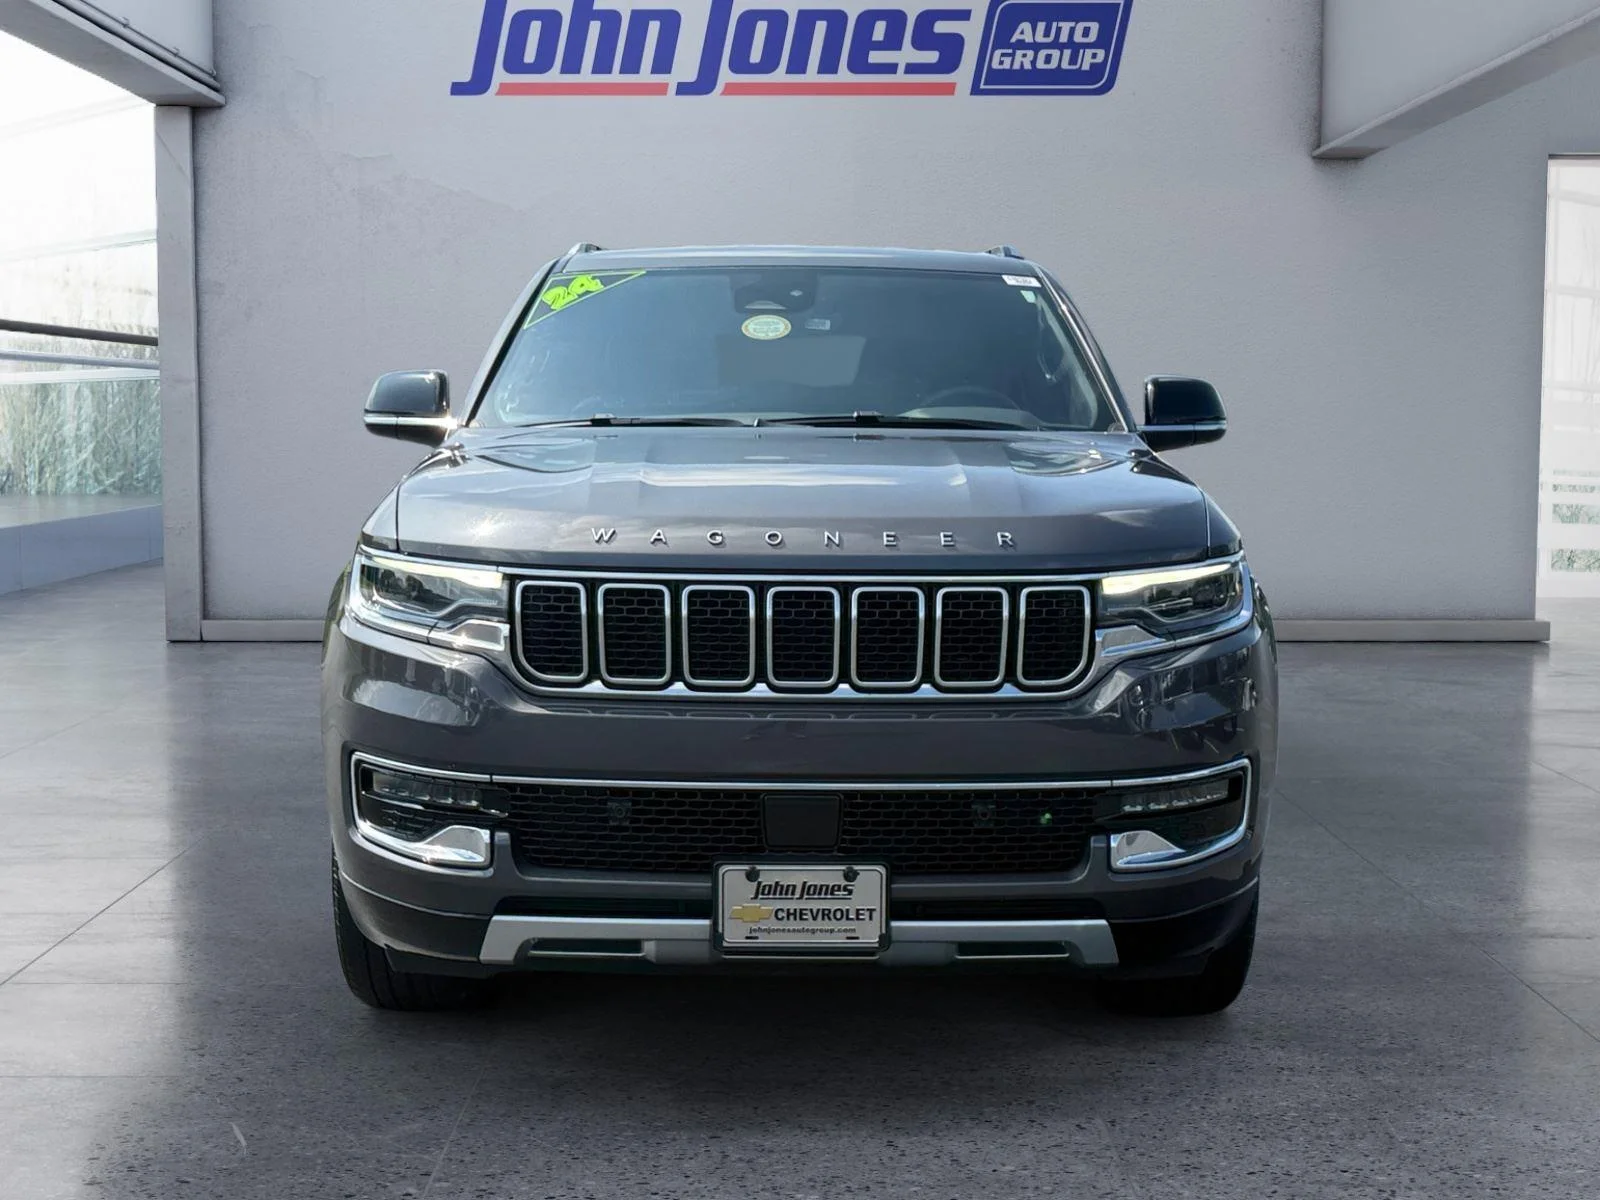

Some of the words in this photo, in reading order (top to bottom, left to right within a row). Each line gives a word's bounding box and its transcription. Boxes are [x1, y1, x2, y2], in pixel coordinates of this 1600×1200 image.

[1010, 21, 1099, 43] AUTO
[450, 0, 682, 96] John
[675, 0, 972, 96] Jones
[991, 49, 1105, 71] GROUP
[591, 527, 1014, 547] WAGONEER
[751, 881, 797, 900] John
[796, 881, 855, 900] Jones
[774, 908, 876, 921] CHEVROLET
[749, 926, 856, 935] johnjonesautogroup.com
